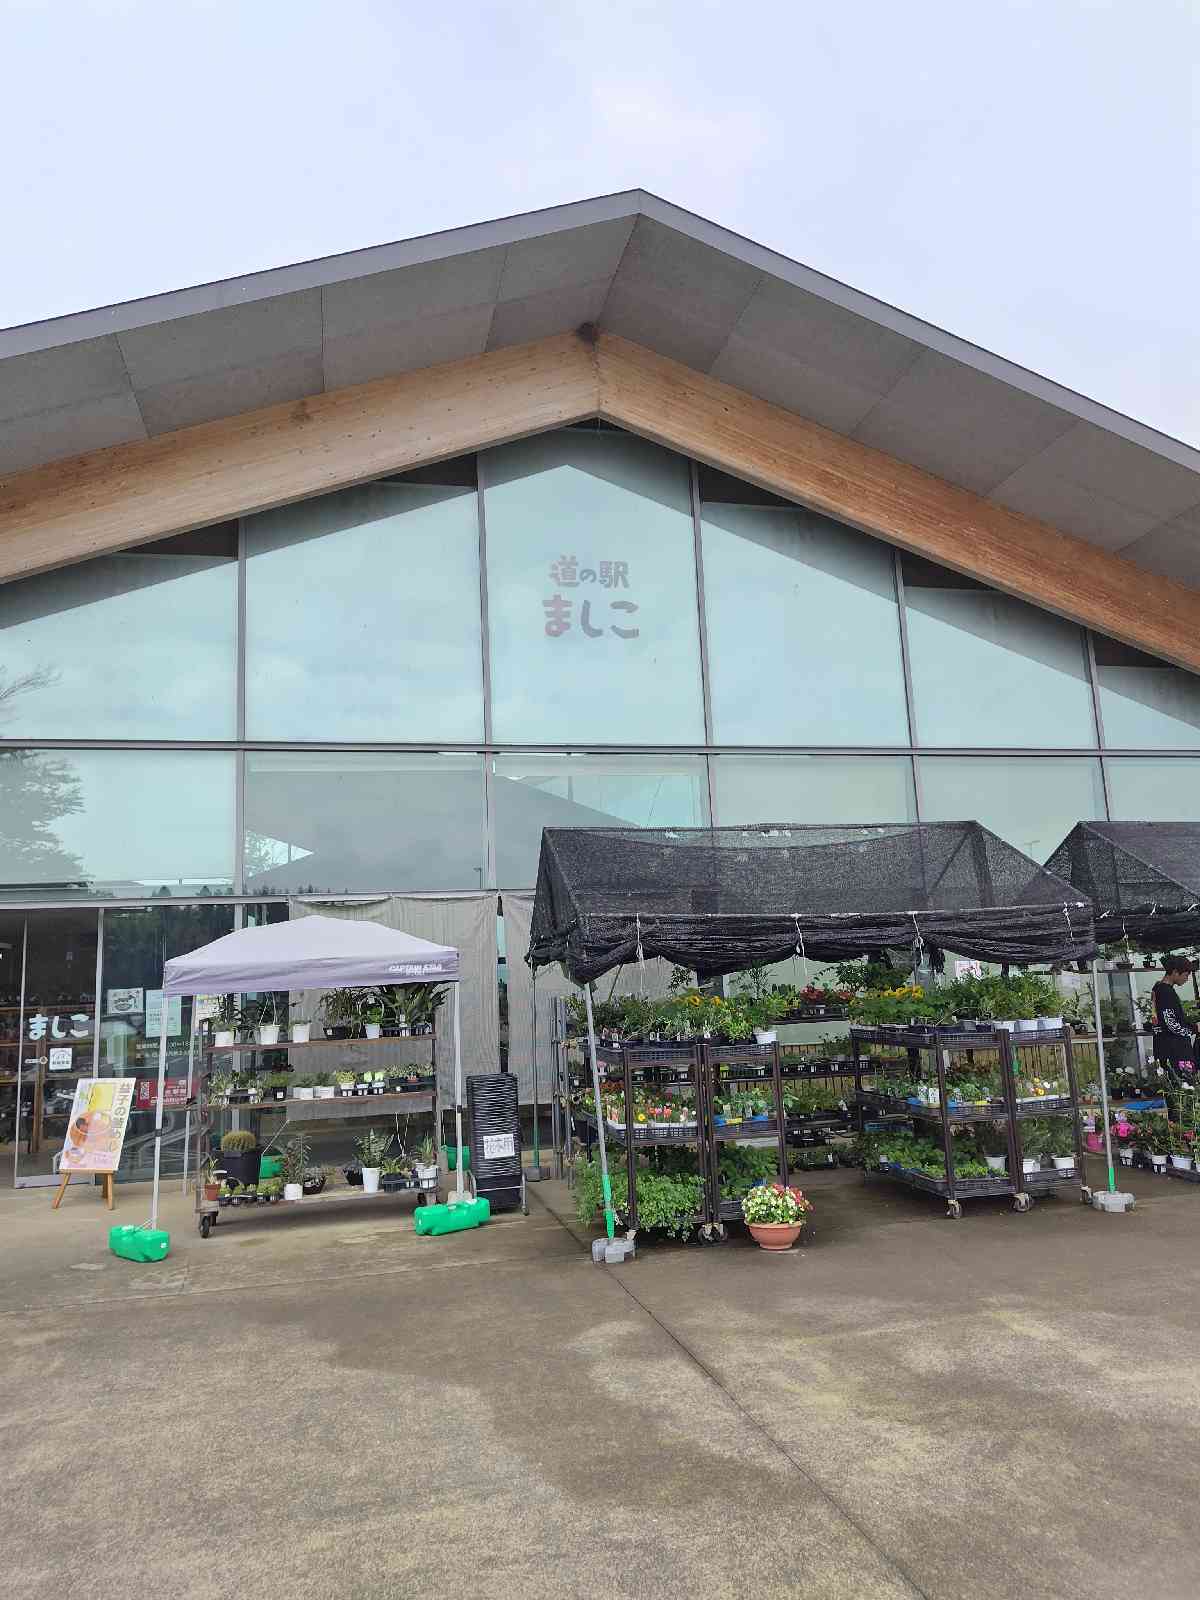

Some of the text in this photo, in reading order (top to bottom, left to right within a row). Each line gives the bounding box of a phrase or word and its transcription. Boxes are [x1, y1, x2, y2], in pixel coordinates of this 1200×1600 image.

[548, 554, 630, 588] 道の駅
[542, 594, 640, 639] ましこ
[28, 1013, 90, 1040] ましこ
